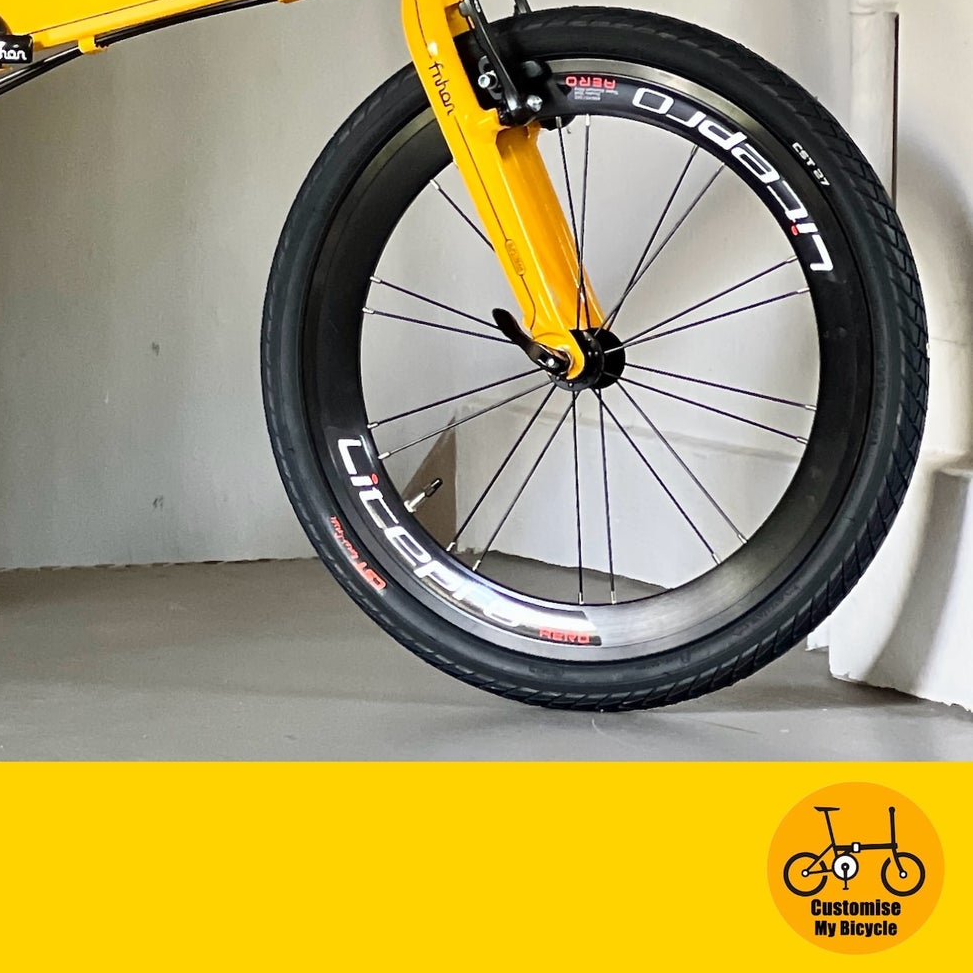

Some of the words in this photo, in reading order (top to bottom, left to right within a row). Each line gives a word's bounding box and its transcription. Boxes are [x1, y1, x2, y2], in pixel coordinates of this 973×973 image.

[565, 76, 616, 89] AERO
[791, 142, 817, 167] CST
[813, 169, 831, 187] 27
[539, 628, 590, 643] AERO
